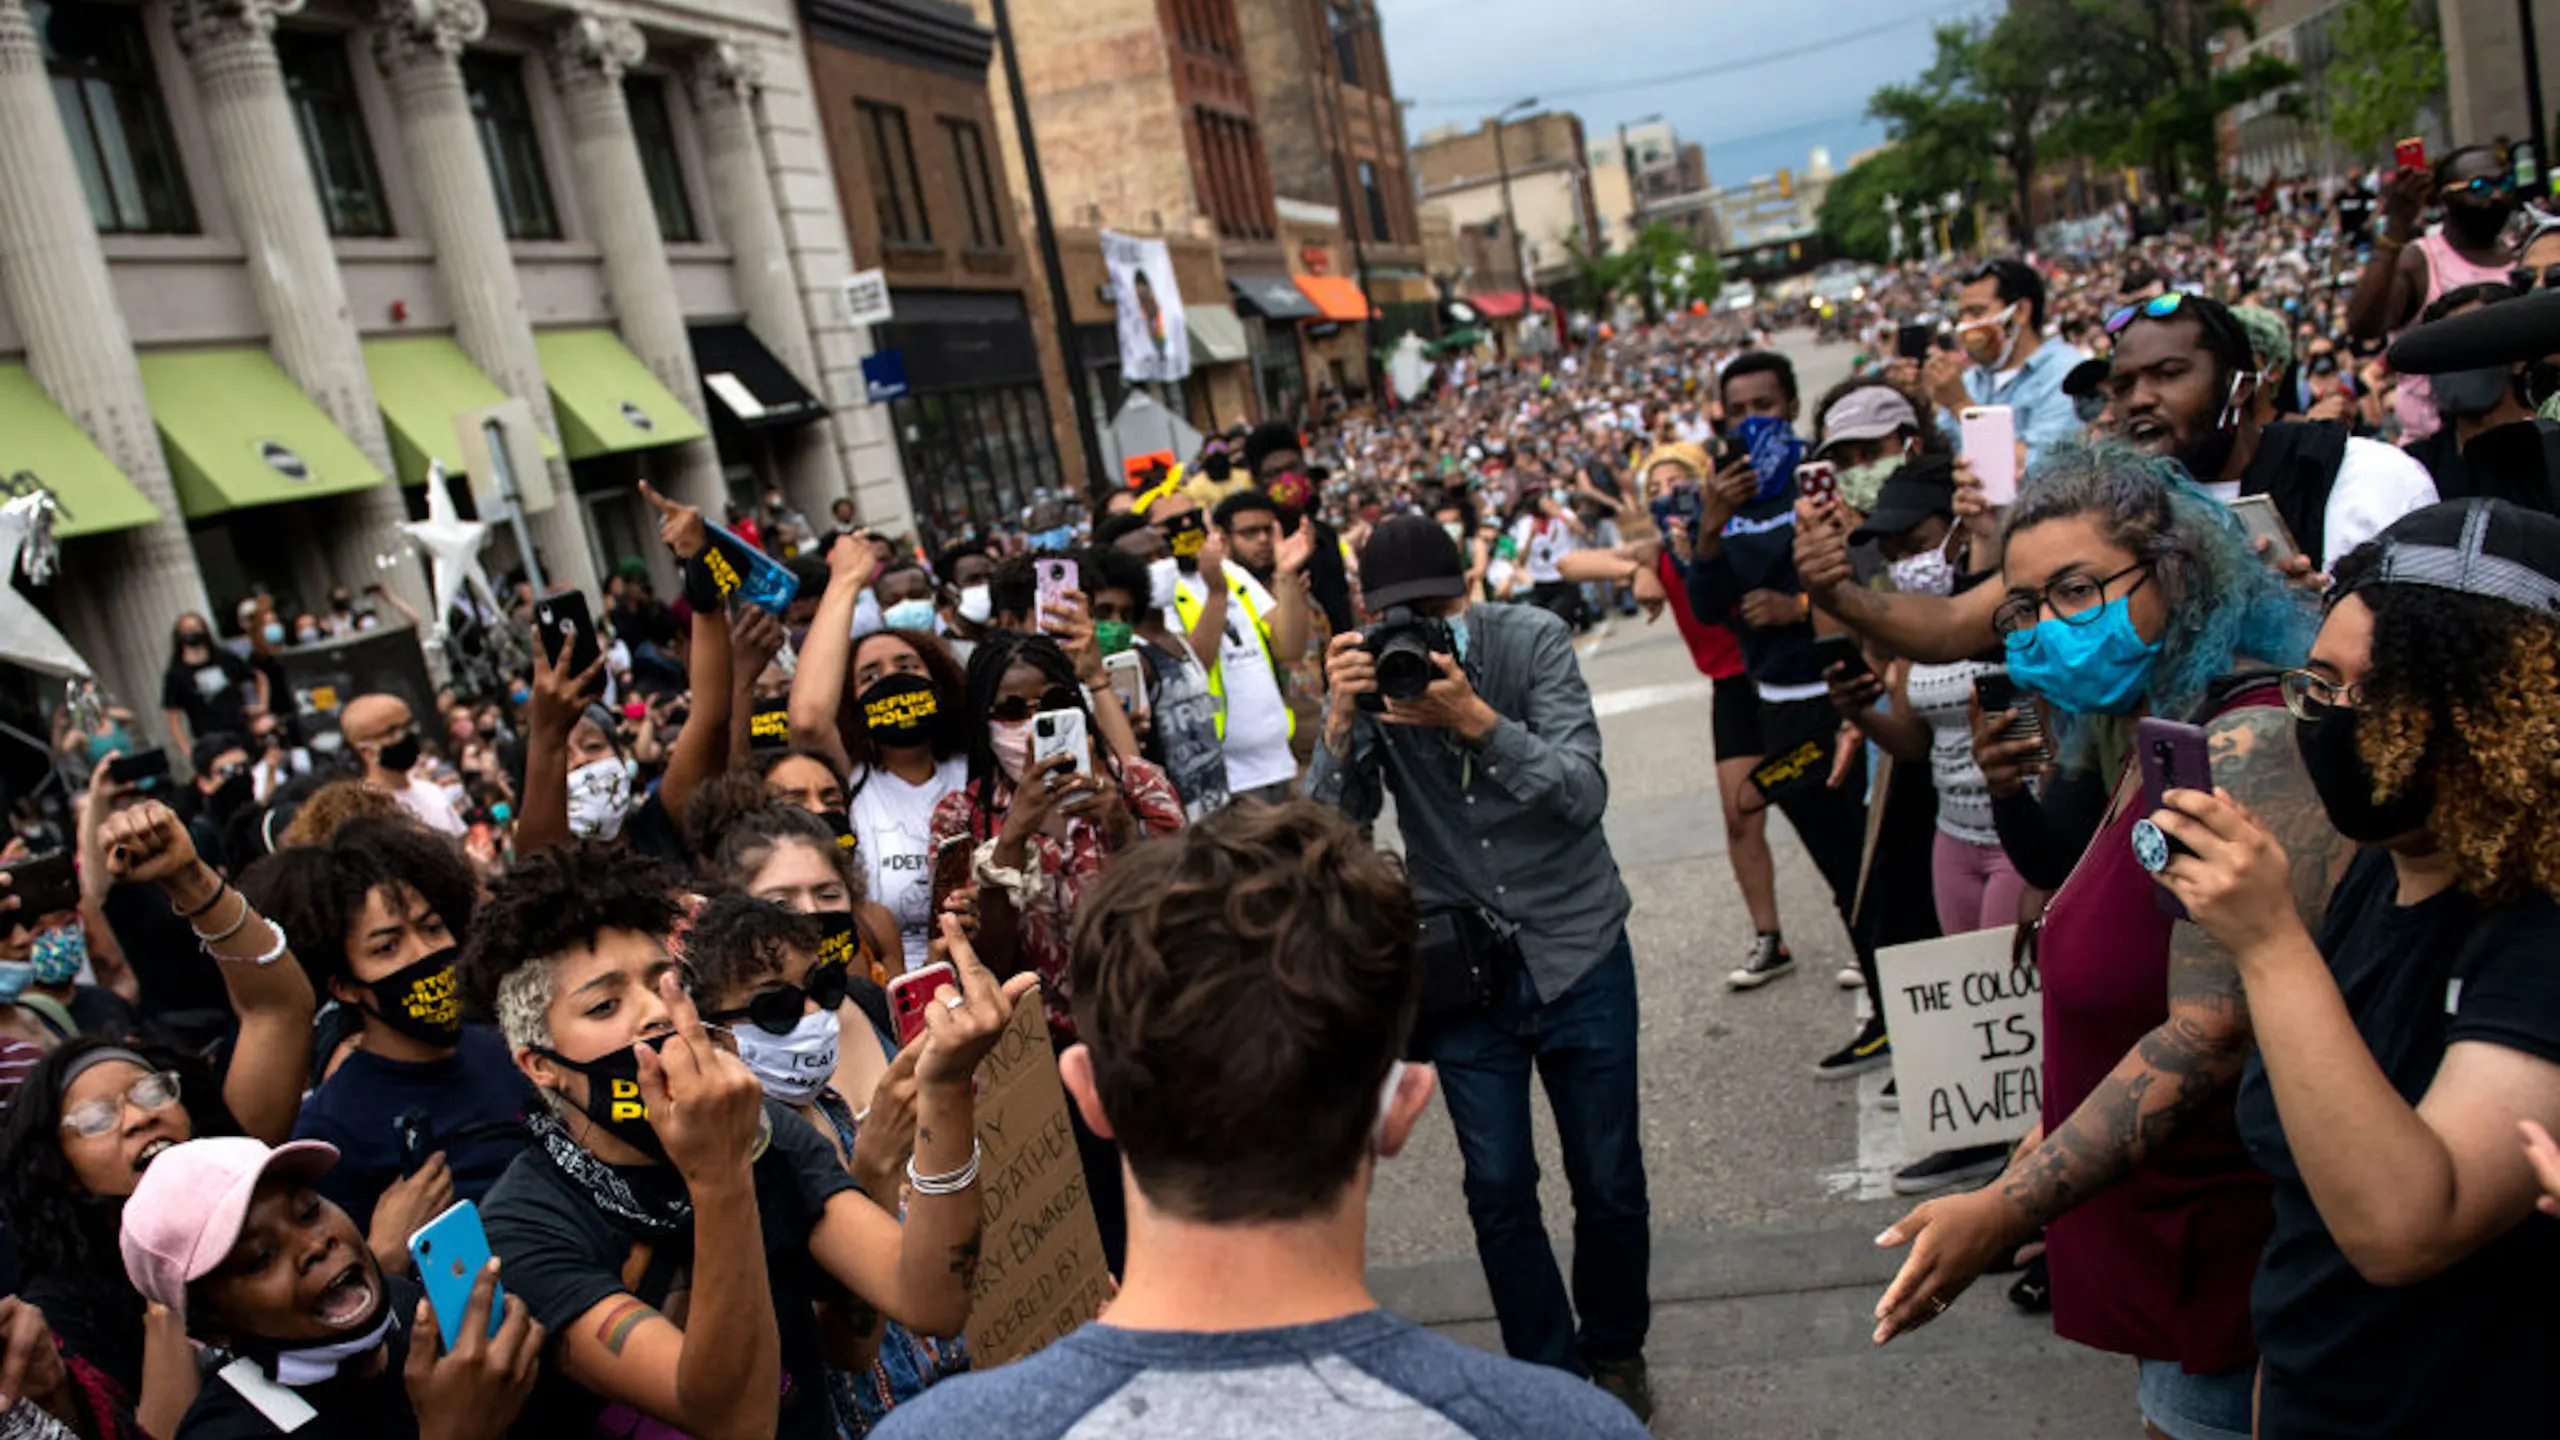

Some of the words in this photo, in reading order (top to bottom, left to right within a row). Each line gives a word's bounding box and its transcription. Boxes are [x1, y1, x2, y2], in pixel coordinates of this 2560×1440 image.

[866, 698, 938, 729] POLICE
[1902, 981, 1951, 1015] THE
[1973, 1014, 2036, 1062] IS
[1929, 1087, 1958, 1132] A
[1955, 1063, 2043, 1126] WEA
[1055, 1239, 1081, 1284] BY
